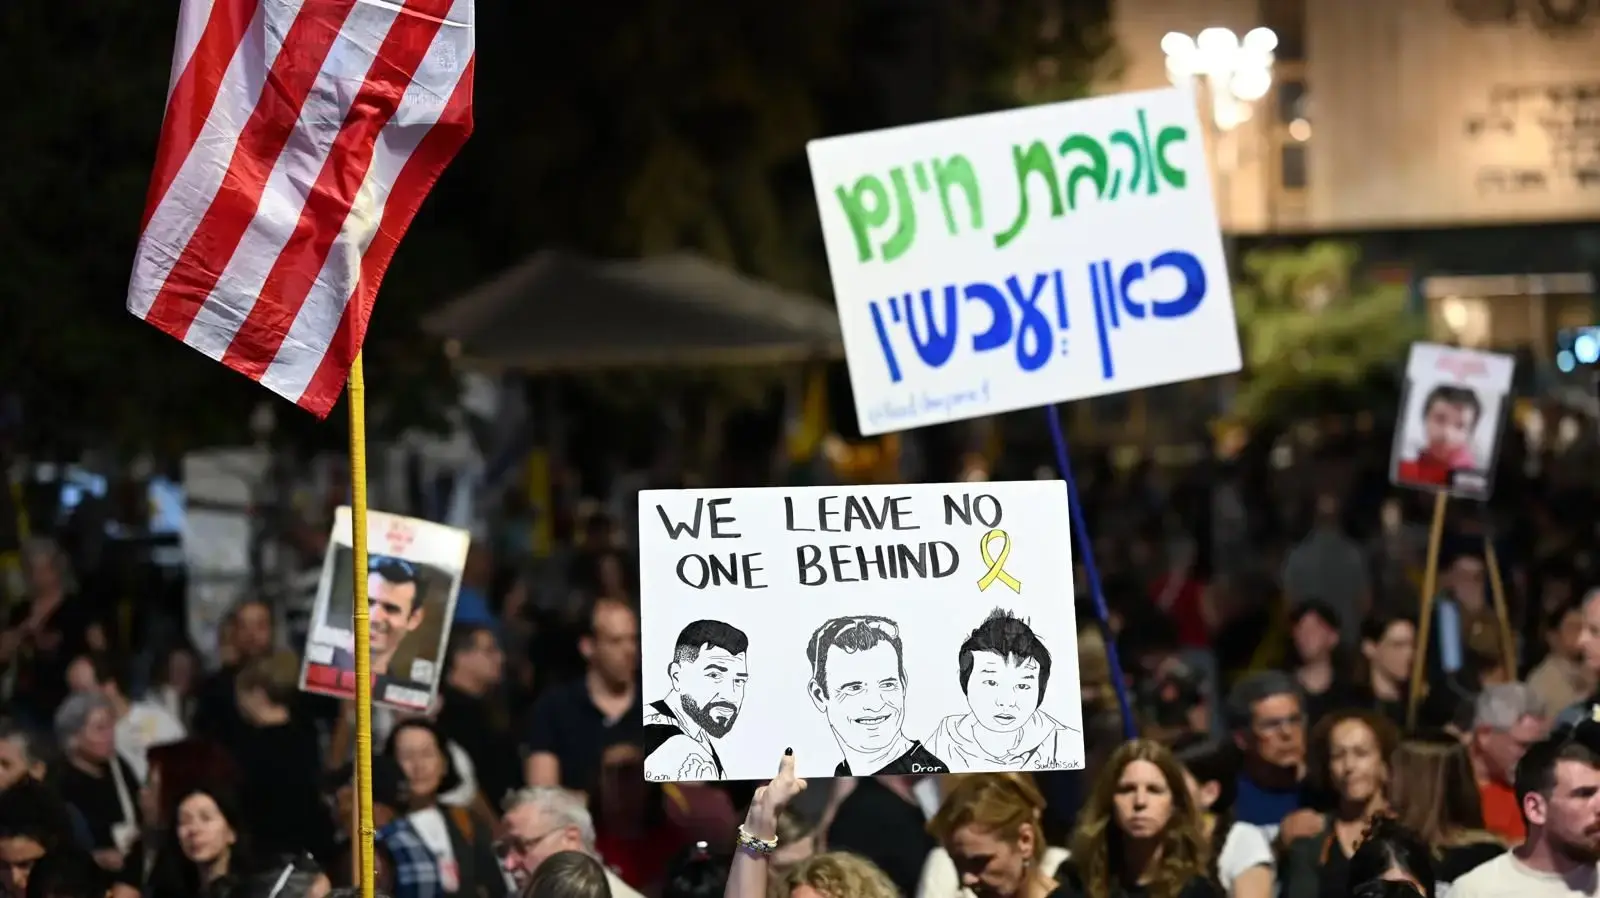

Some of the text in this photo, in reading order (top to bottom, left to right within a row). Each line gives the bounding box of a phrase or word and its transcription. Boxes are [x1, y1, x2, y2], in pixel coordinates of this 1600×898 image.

[834, 109, 1187, 263] אהבת חינם
[1088, 249, 1208, 380] כאן
[656, 493, 1003, 540] WE LEAVE NO
[676, 540, 961, 590] ONE BEHIND
[911, 762, 943, 773] Dror
